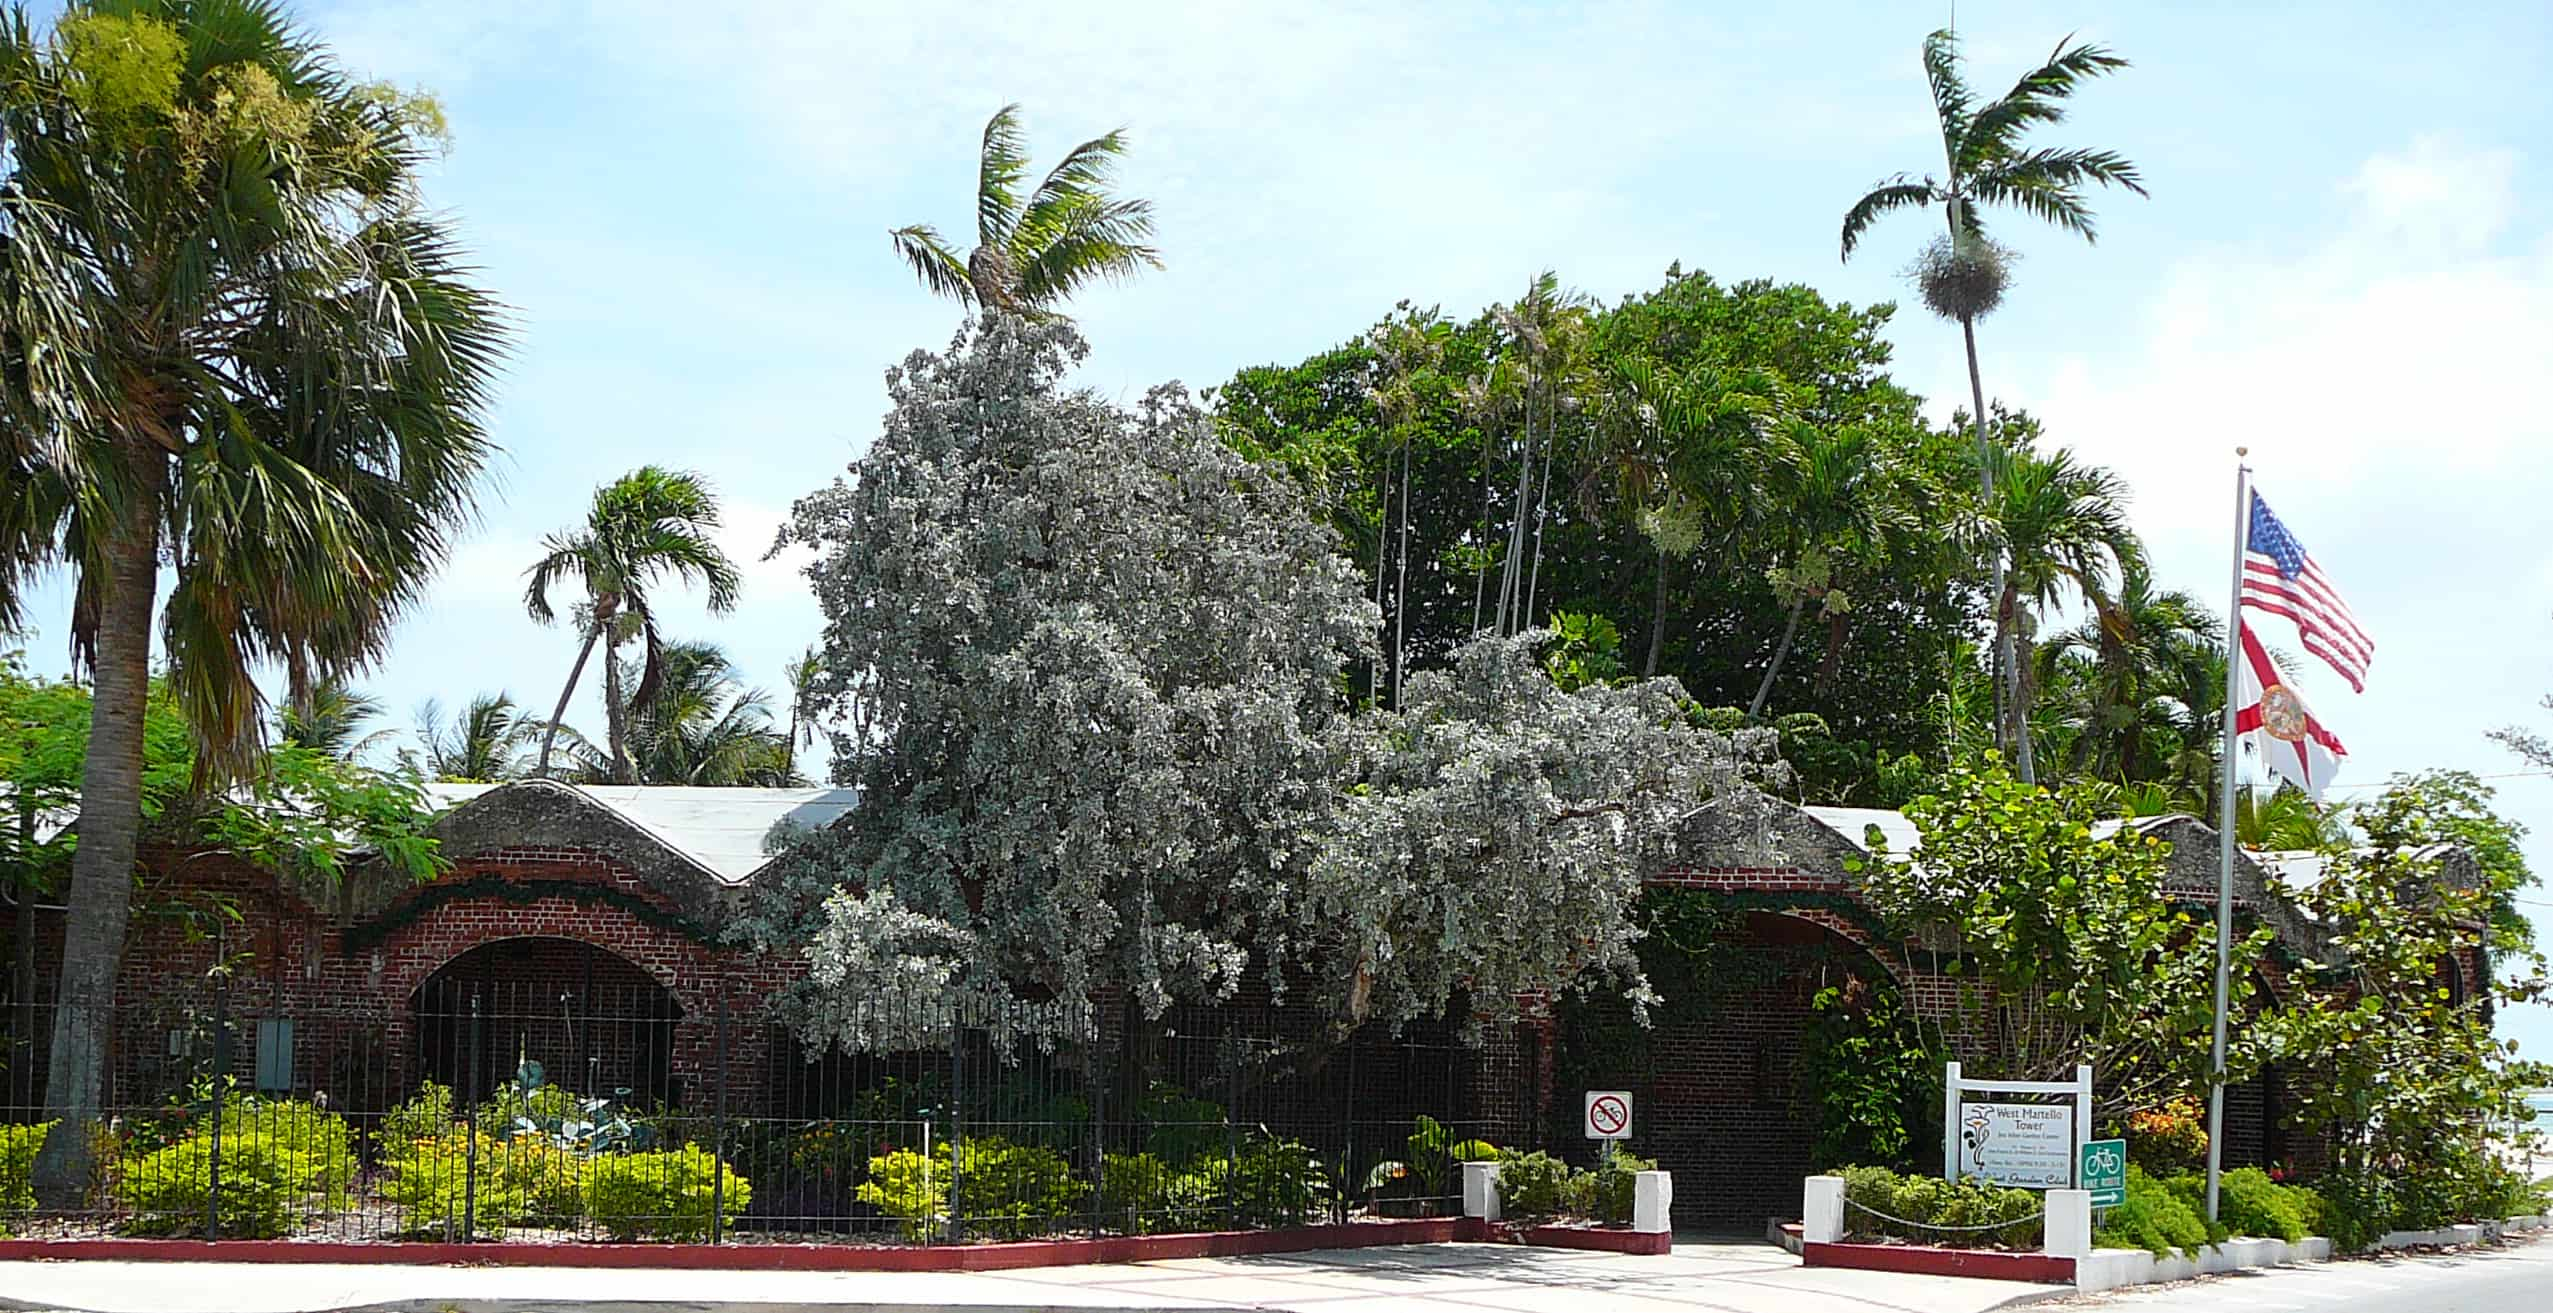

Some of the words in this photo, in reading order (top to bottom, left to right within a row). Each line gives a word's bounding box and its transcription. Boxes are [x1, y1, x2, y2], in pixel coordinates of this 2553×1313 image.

[1997, 1107, 2020, 1119] West
[2022, 1108, 2063, 1120] Martello
[2015, 1120, 2045, 1130] Tower
[2046, 1173, 2068, 1185] Club
